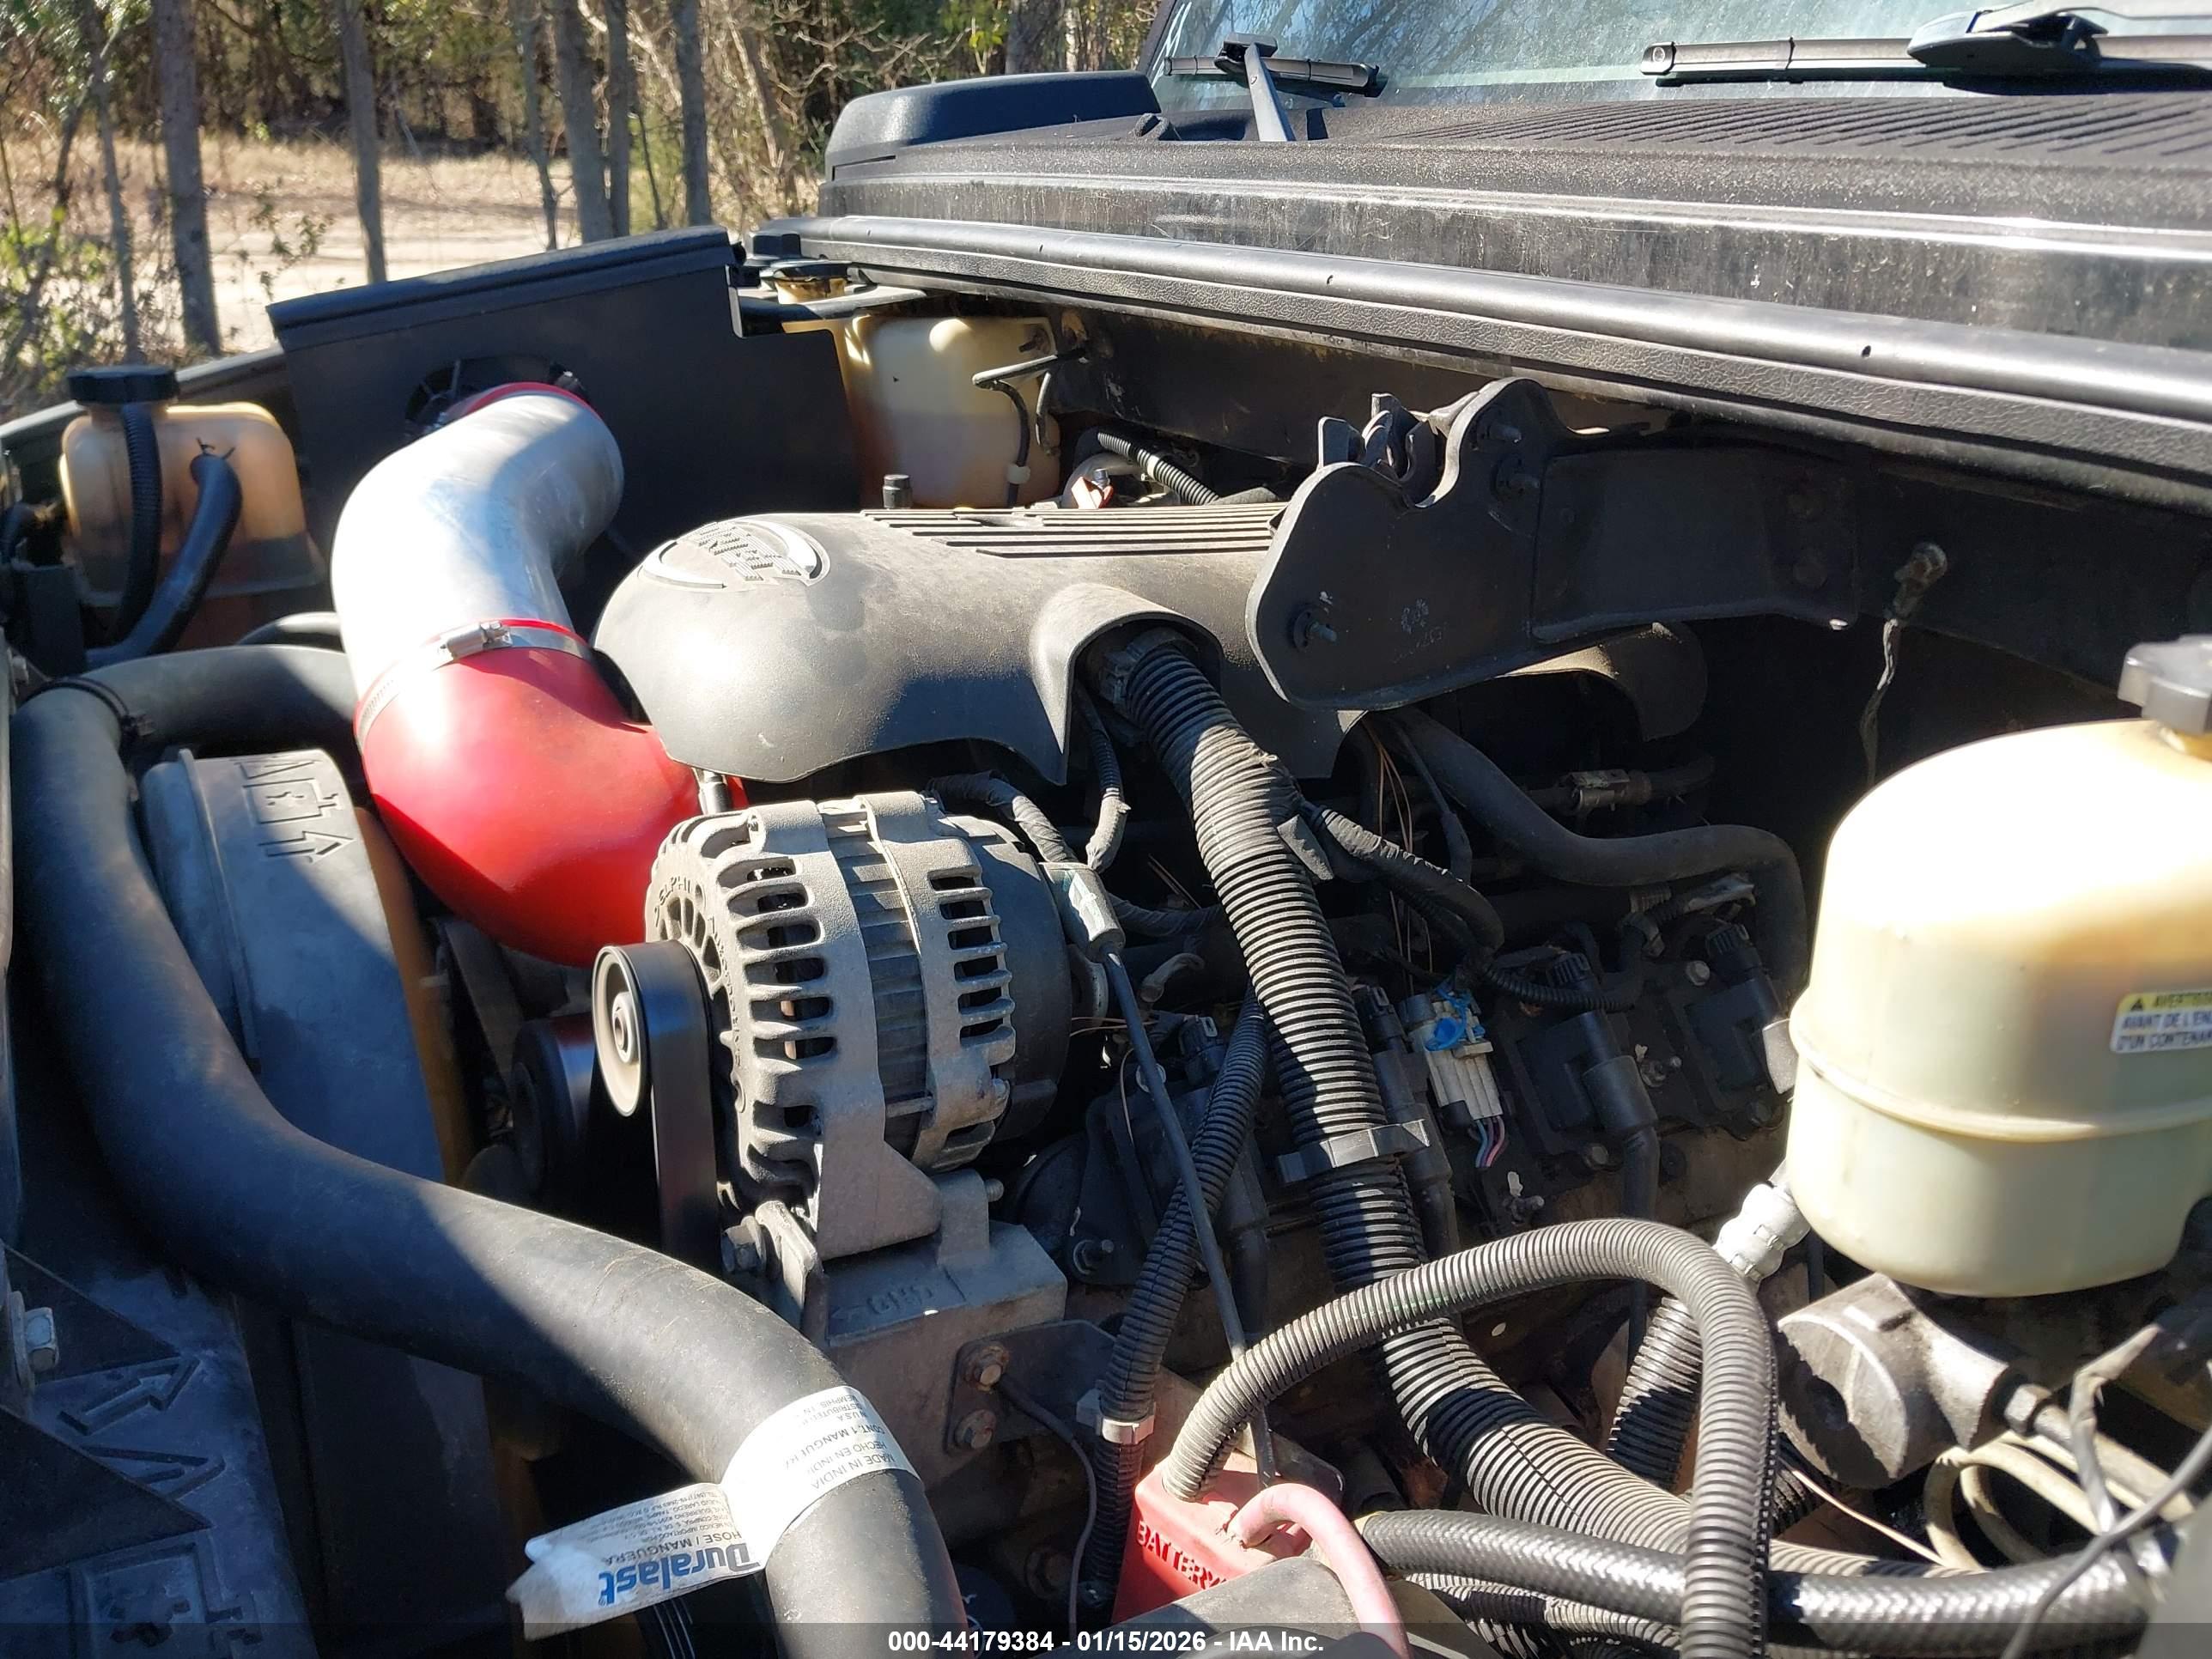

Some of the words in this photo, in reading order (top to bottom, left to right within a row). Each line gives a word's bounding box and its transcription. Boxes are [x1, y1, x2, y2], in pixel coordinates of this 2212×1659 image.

[850, 1425, 858, 1435] 1
[834, 1446, 852, 1458] EN
[852, 1439, 887, 1453] HECHO
[848, 1457, 864, 1473] IN
[863, 1451, 896, 1466] MADE
[811, 1463, 848, 1490] INDIA
[704, 1530, 742, 1545] HOSE
[603, 1537, 692, 1566] MANGUERA
[1136, 1520, 1223, 1591] BATTERY
[598, 1543, 760, 1606] Duralast
